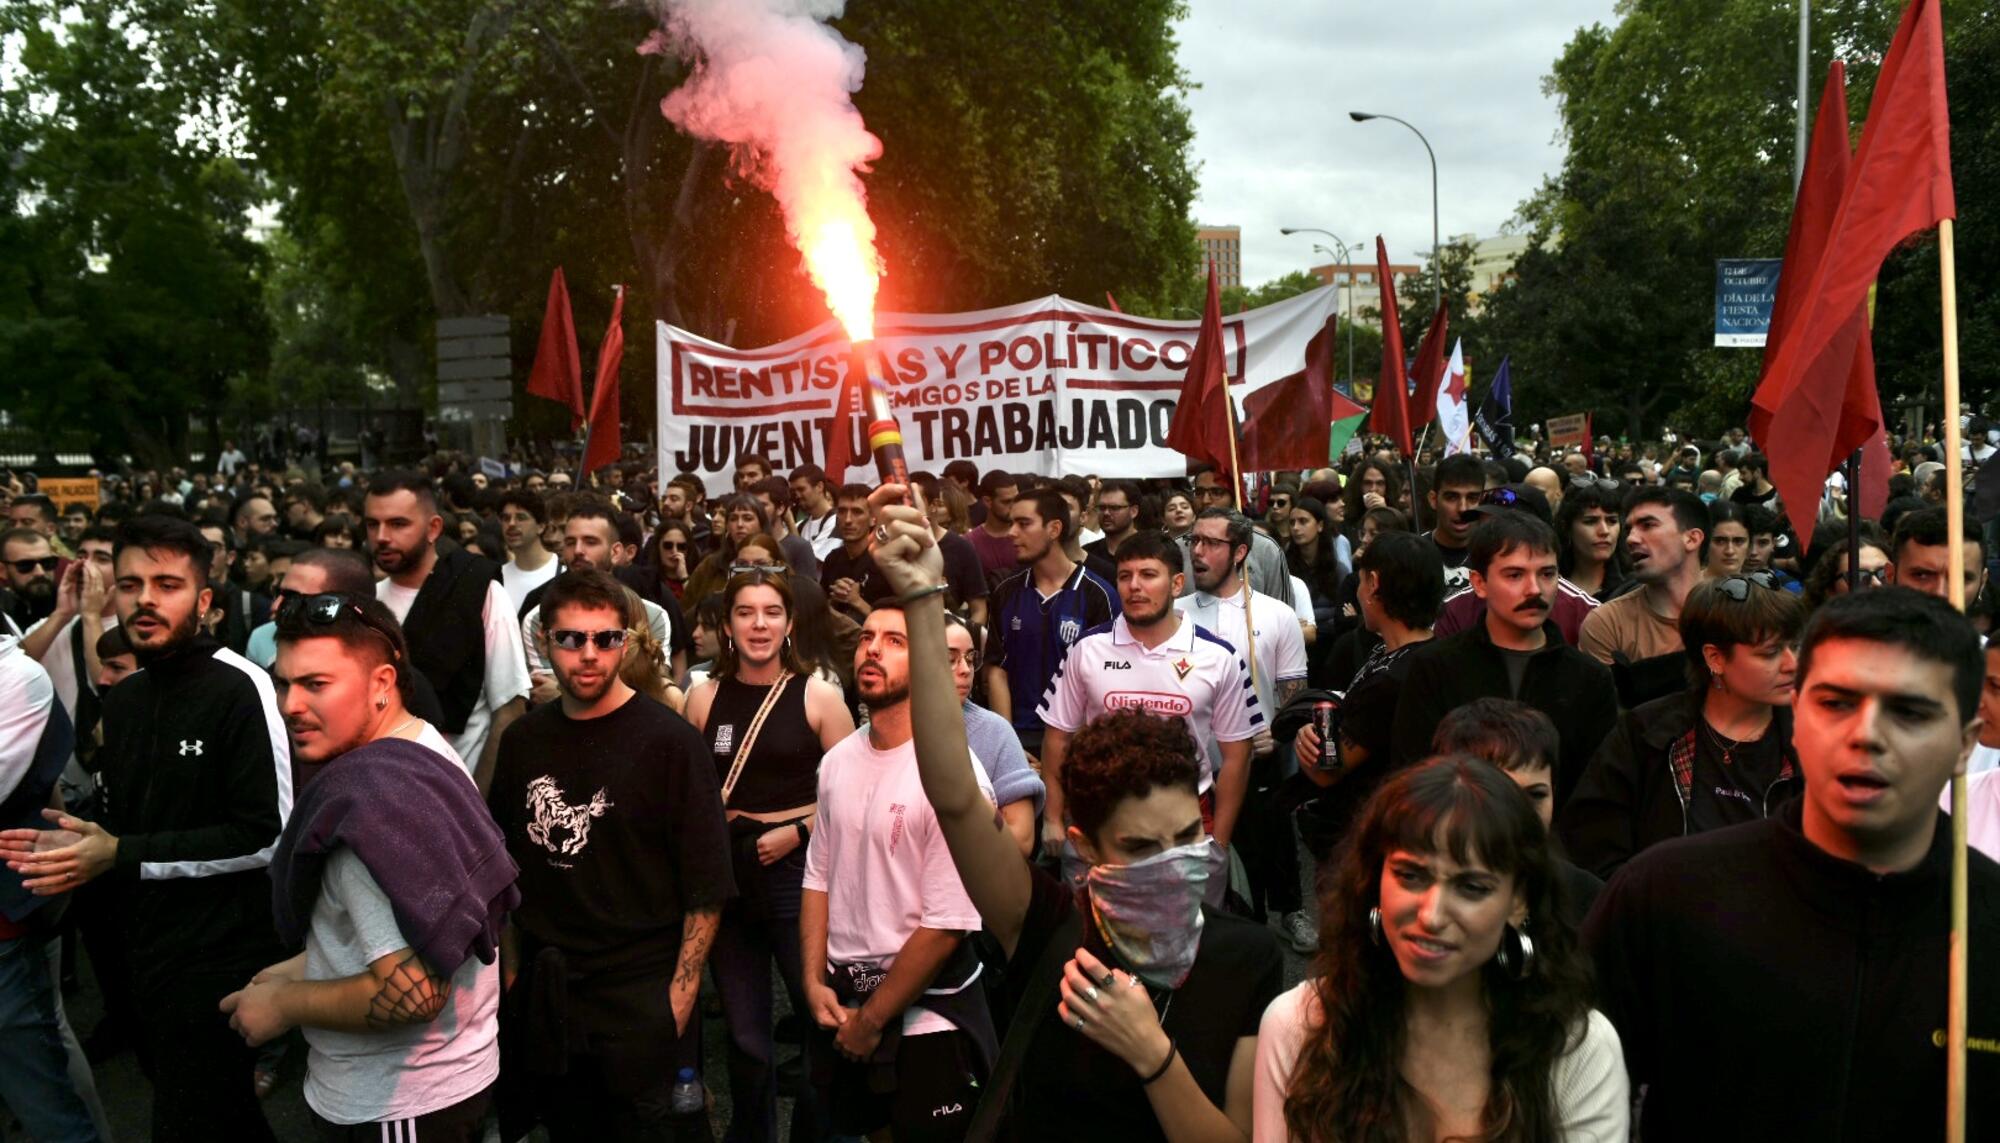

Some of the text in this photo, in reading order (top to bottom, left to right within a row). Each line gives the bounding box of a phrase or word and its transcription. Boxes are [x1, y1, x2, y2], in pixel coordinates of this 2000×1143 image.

[1744, 294, 1761, 303] DE
[1722, 306, 1758, 315] FIESTA
[1722, 317, 1771, 327] NACIONA
[934, 343, 967, 380] Y
[979, 323, 1195, 376] POLÍTICO
[986, 378, 1021, 400] DE
[1025, 374, 1057, 397] LA
[674, 412, 900, 473] JUVENTU
[1104, 660, 1132, 670] FILA
[1111, 696, 1184, 712] Nintendo
